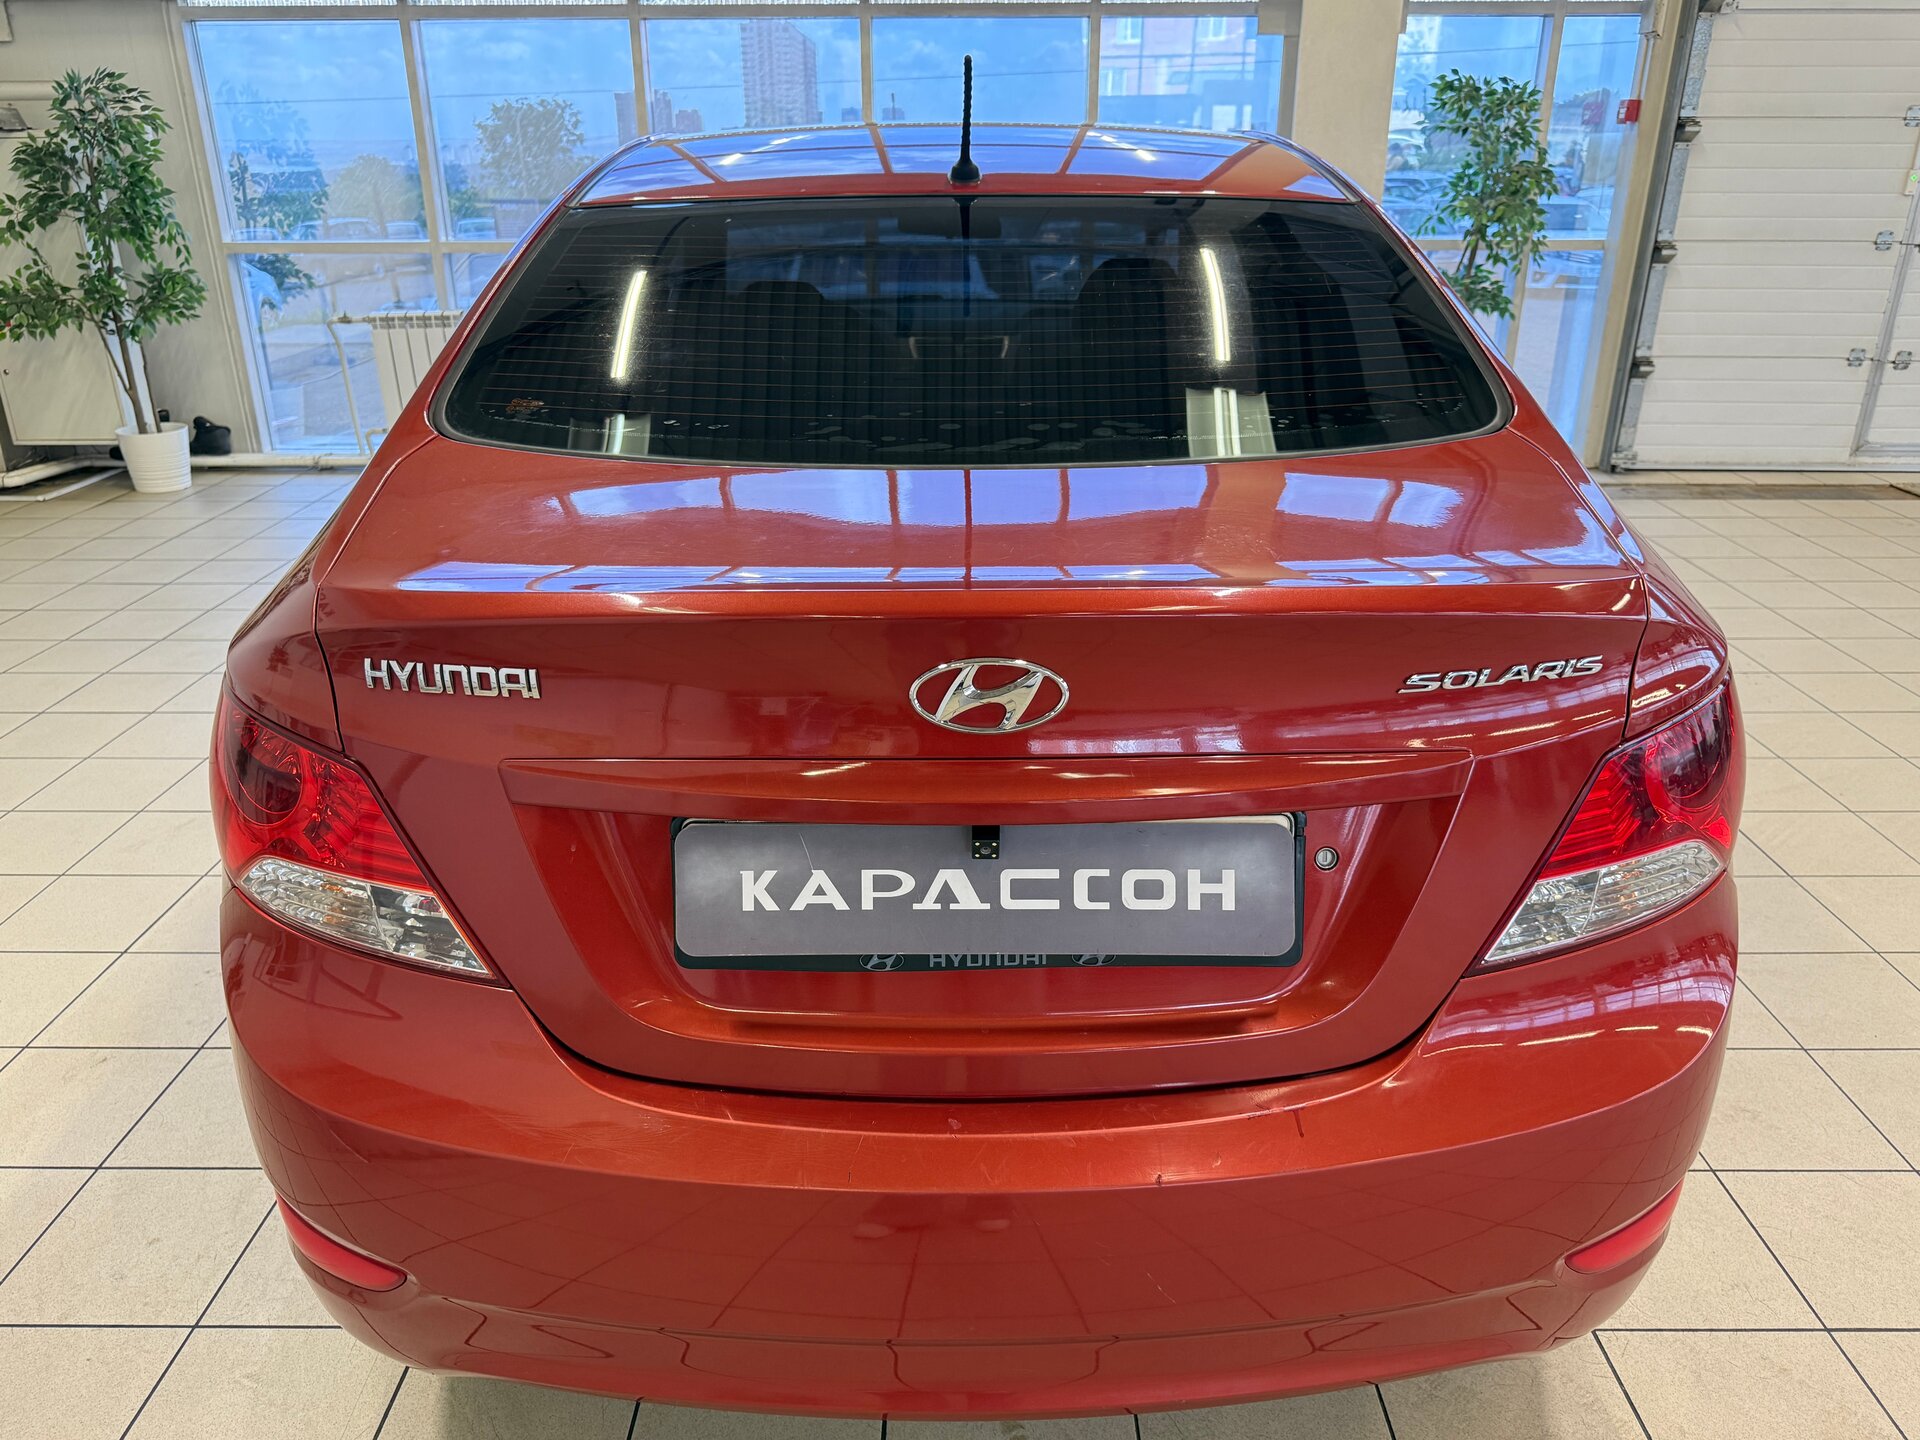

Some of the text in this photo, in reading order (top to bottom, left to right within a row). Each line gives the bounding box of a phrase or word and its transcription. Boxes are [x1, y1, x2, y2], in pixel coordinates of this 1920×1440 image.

[364, 657, 541, 699] HYUNDAI
[1398, 655, 1603, 694] SOLARIS
[929, 953, 1048, 968] HYUNDAI
